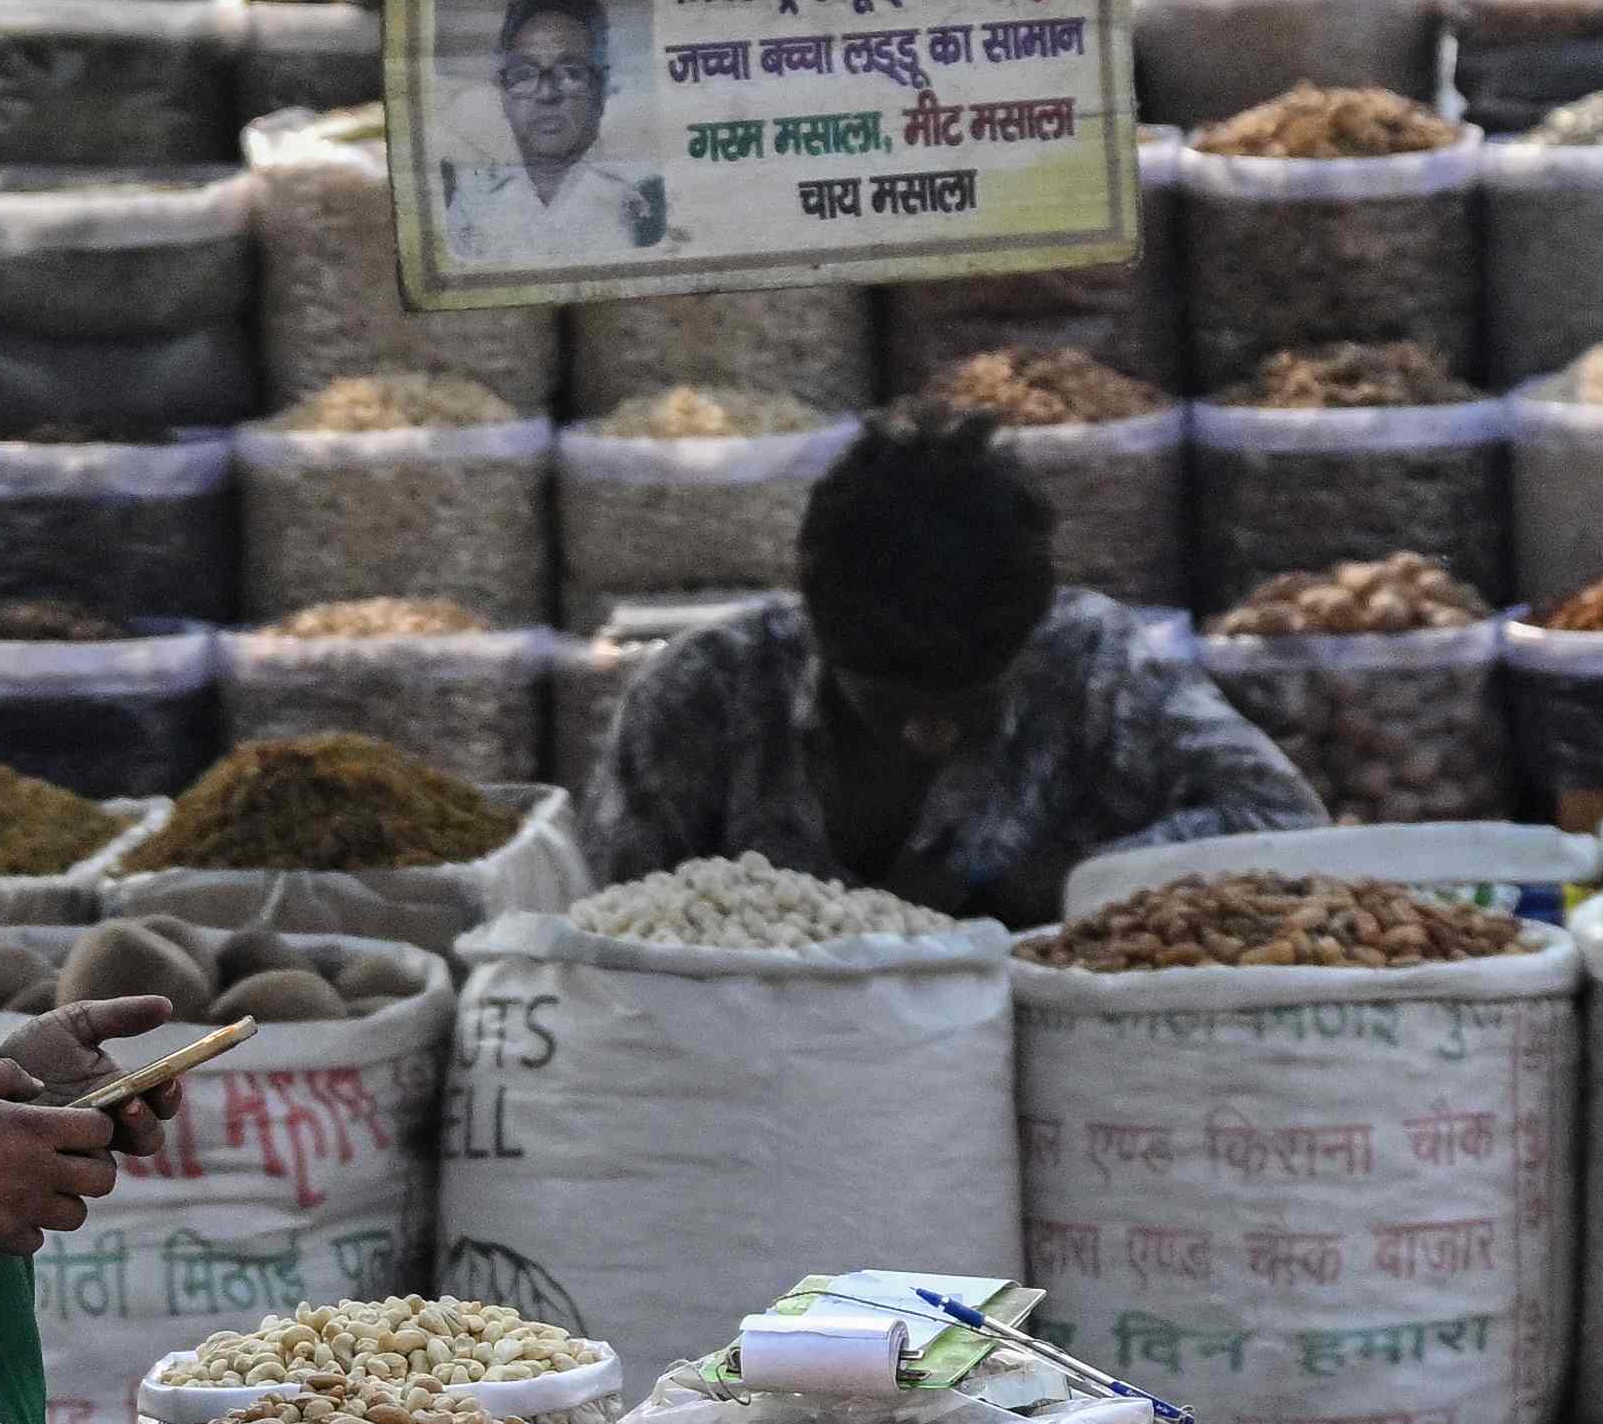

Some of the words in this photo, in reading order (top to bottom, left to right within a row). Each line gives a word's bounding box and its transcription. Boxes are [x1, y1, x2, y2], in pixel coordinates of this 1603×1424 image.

[665, 40, 752, 83] जच्चा
[759, 35, 835, 76] बच्चा
[927, 24, 974, 65] का
[981, 16, 1086, 63] सामान
[687, 119, 766, 163] गरम
[902, 89, 966, 148] मीट
[968, 97, 1075, 142] मसाला
[798, 177, 862, 220] चाय
[868, 169, 978, 215] मसाला
